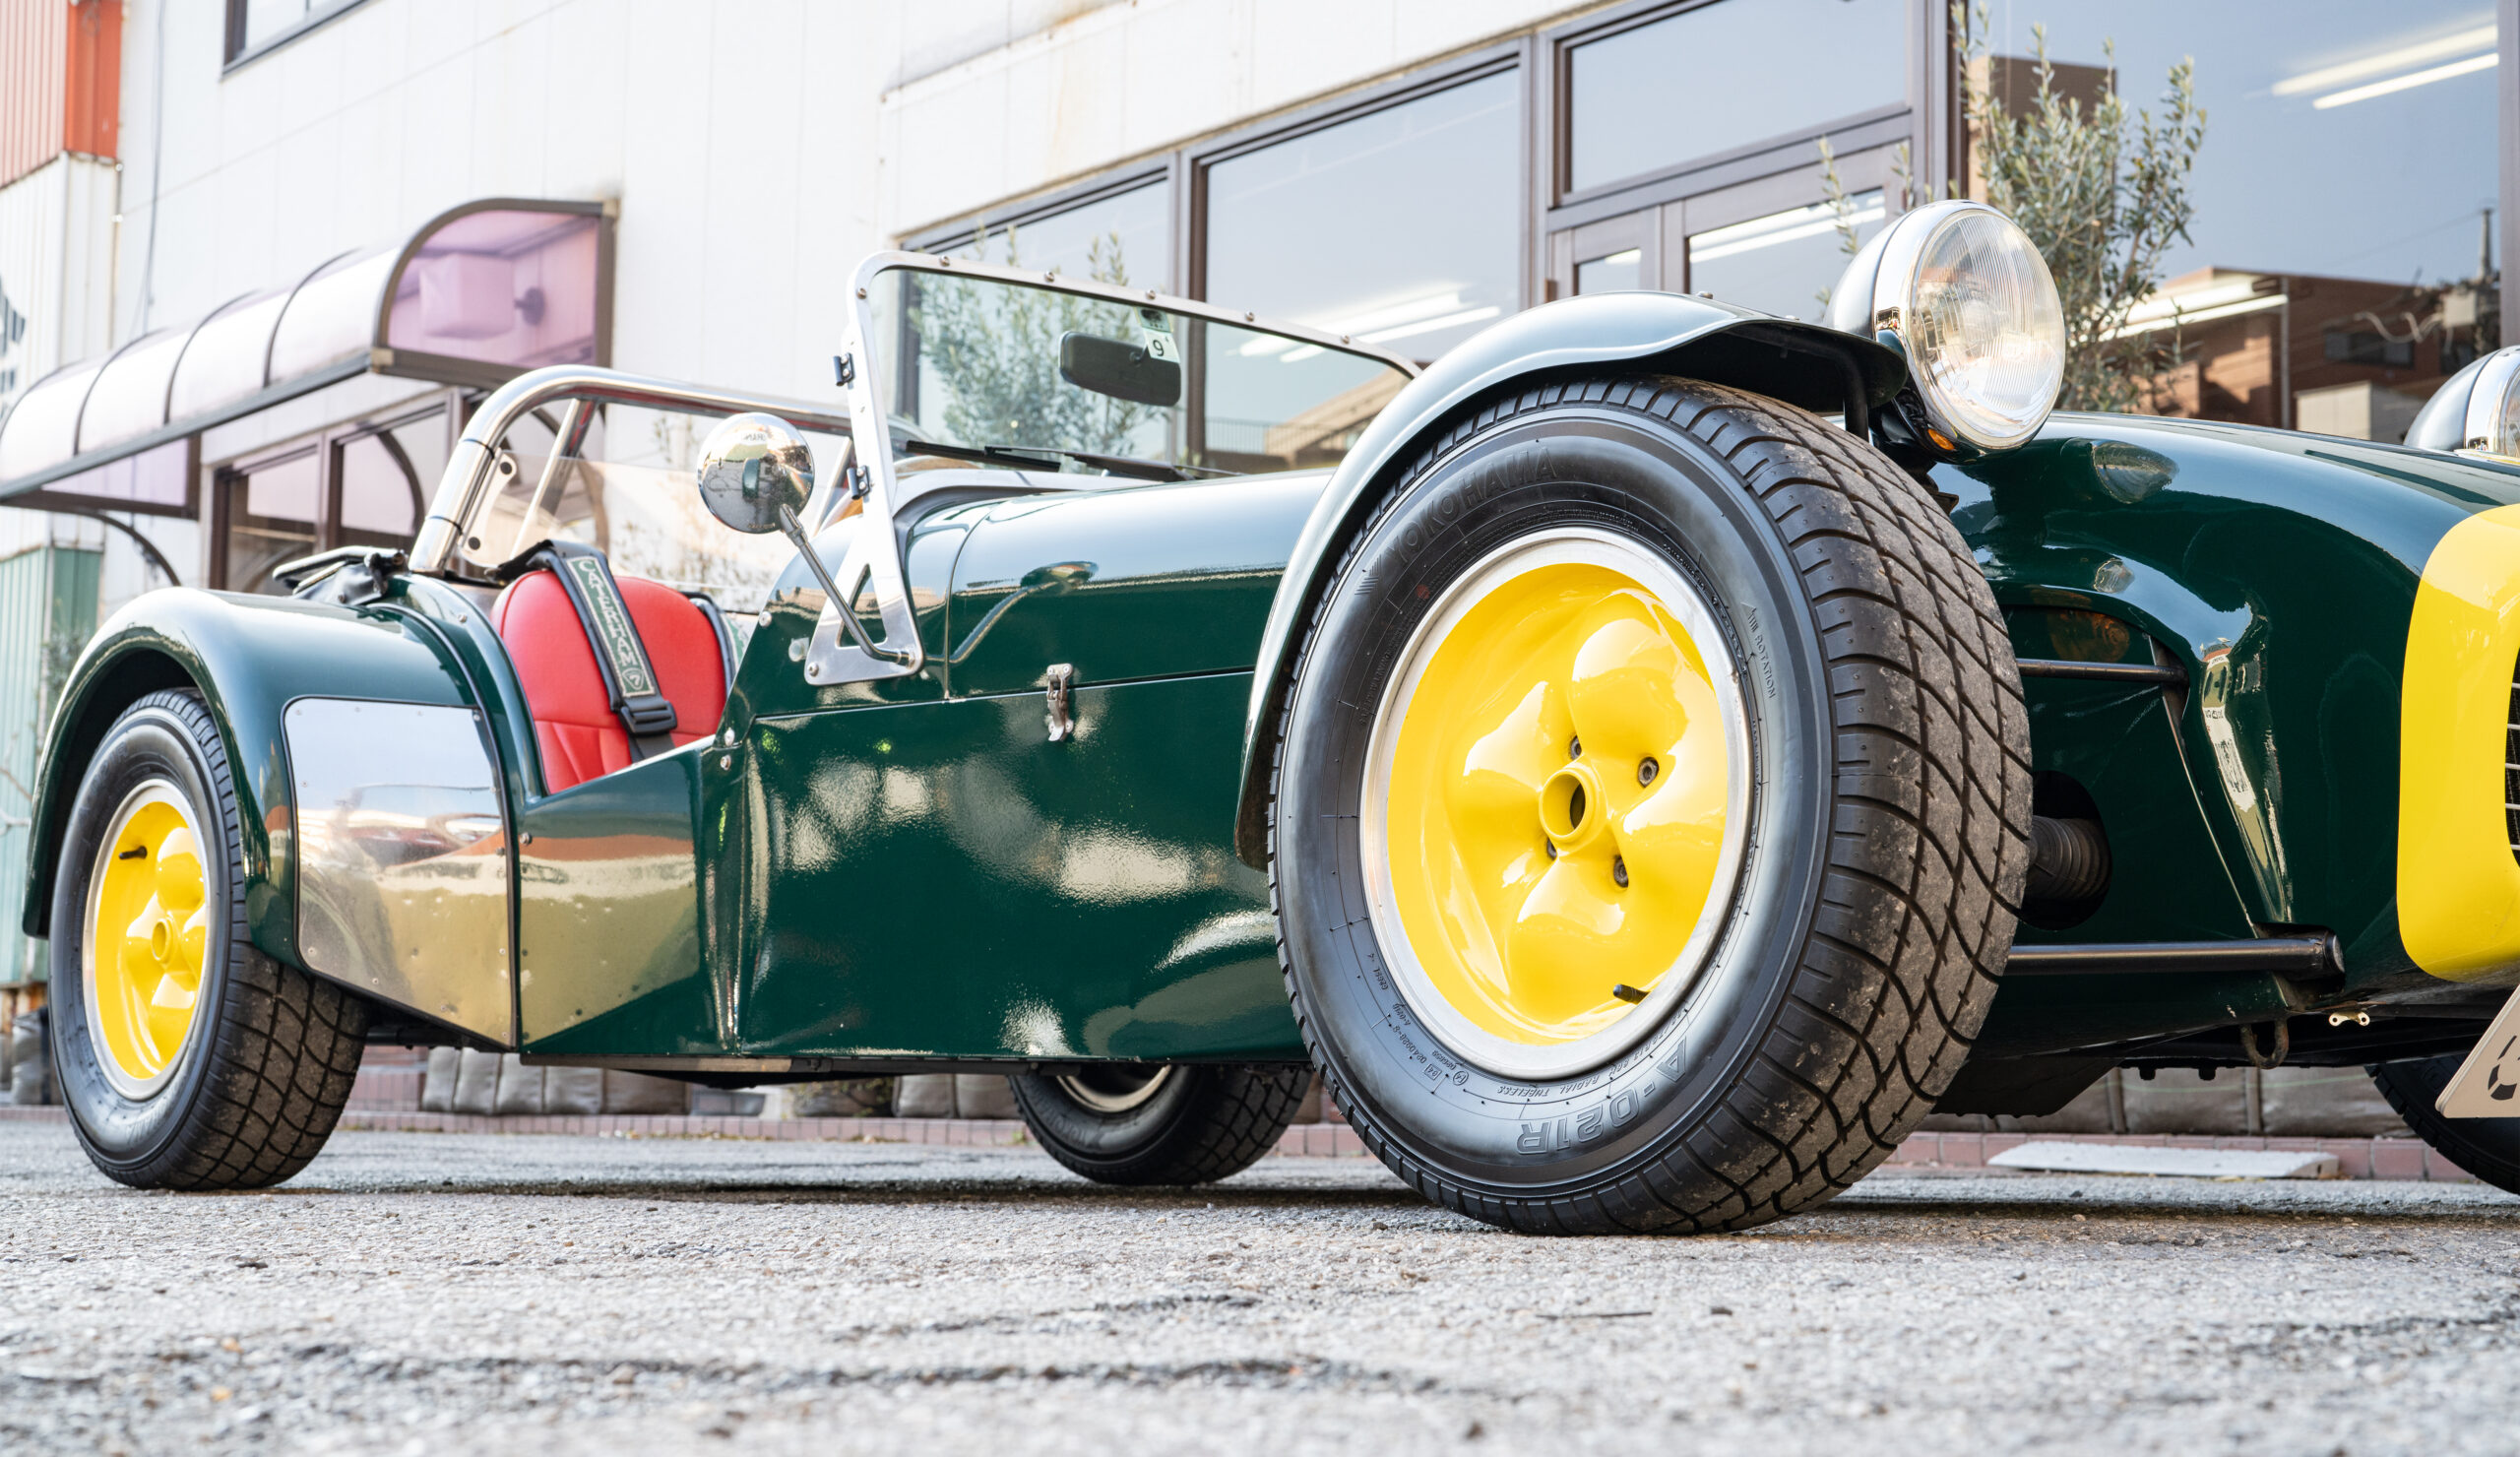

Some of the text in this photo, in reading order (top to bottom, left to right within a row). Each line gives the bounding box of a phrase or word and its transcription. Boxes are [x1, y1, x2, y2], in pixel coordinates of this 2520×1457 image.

[1153, 339, 1165, 356] 9
[1385, 447, 1557, 563] YOKOHAMA
[578, 559, 639, 666] CATERHAM
[1754, 634, 1777, 699] ROTATION
[1497, 1084, 1550, 1098] TUBELESS
[1517, 1035, 1687, 1156] A-021R
[1559, 1074, 1601, 1095] RADIAL
